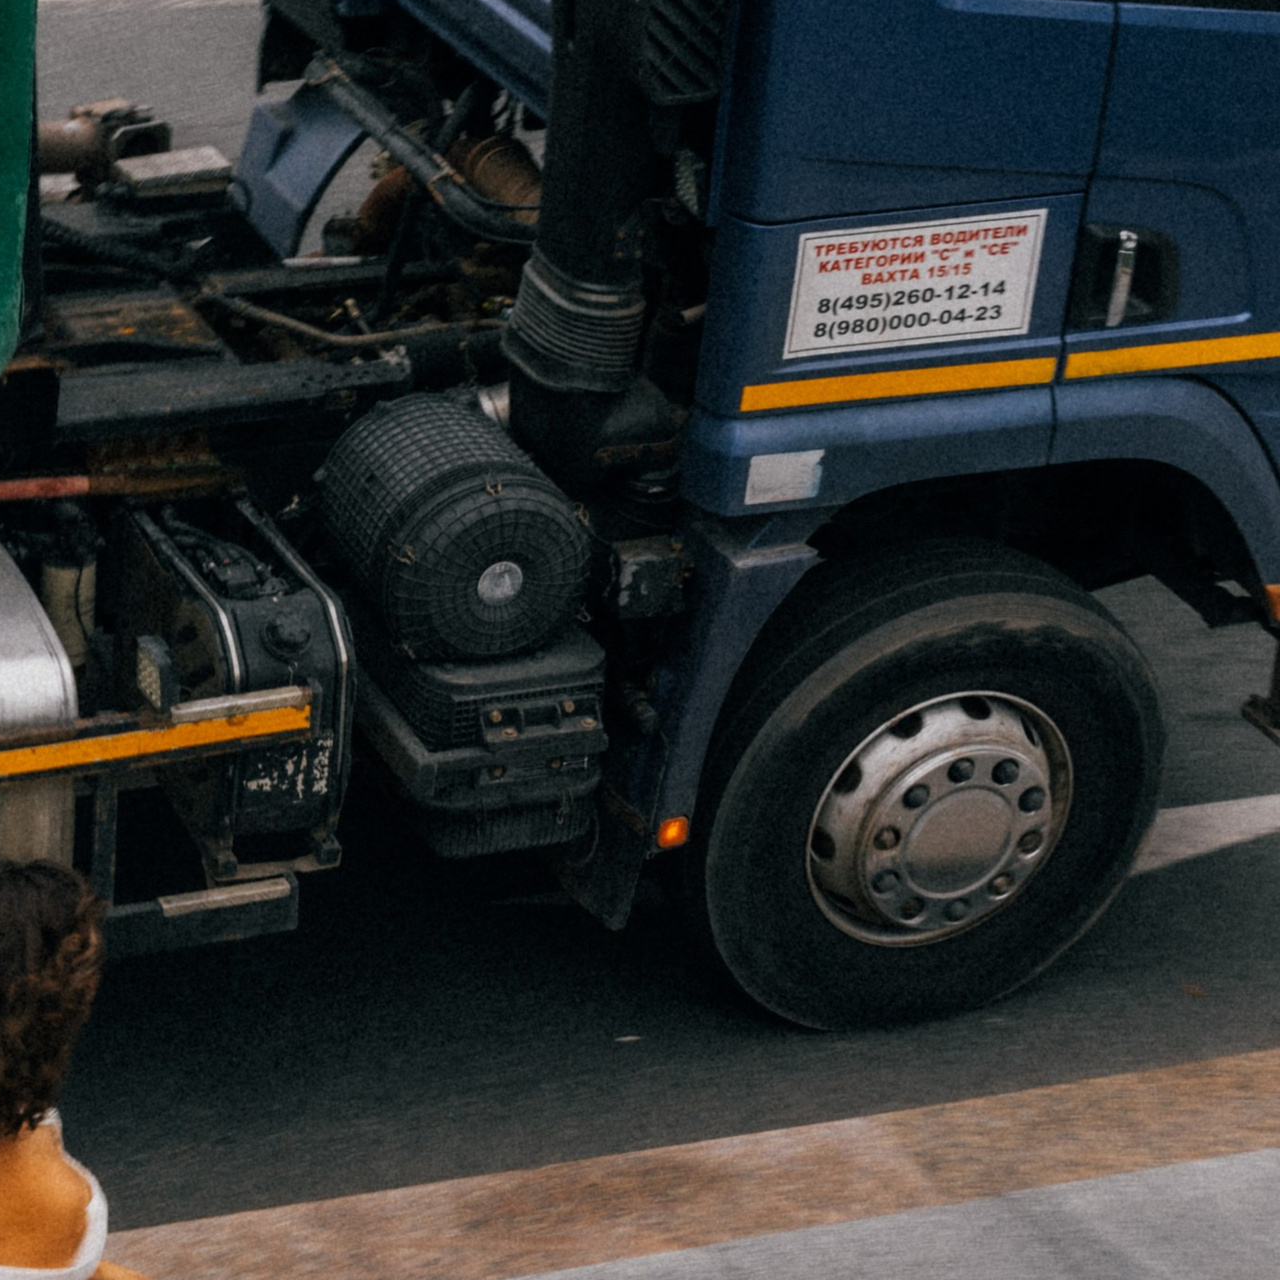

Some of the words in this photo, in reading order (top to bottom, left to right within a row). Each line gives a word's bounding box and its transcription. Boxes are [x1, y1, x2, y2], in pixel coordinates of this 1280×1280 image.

[814, 235, 924, 259] ТРЕБУЮТСЯ
[930, 224, 1028, 245] ВОДИТЕЛИ
[818, 250, 926, 274] КАТЕГОРИИ
[861, 268, 921, 286] ВАХТА
[928, 262, 973, 279] 15/15
[817, 280, 1006, 317] 8(495)260-12-14
[813, 304, 1002, 340] 8(980)000-04-23
